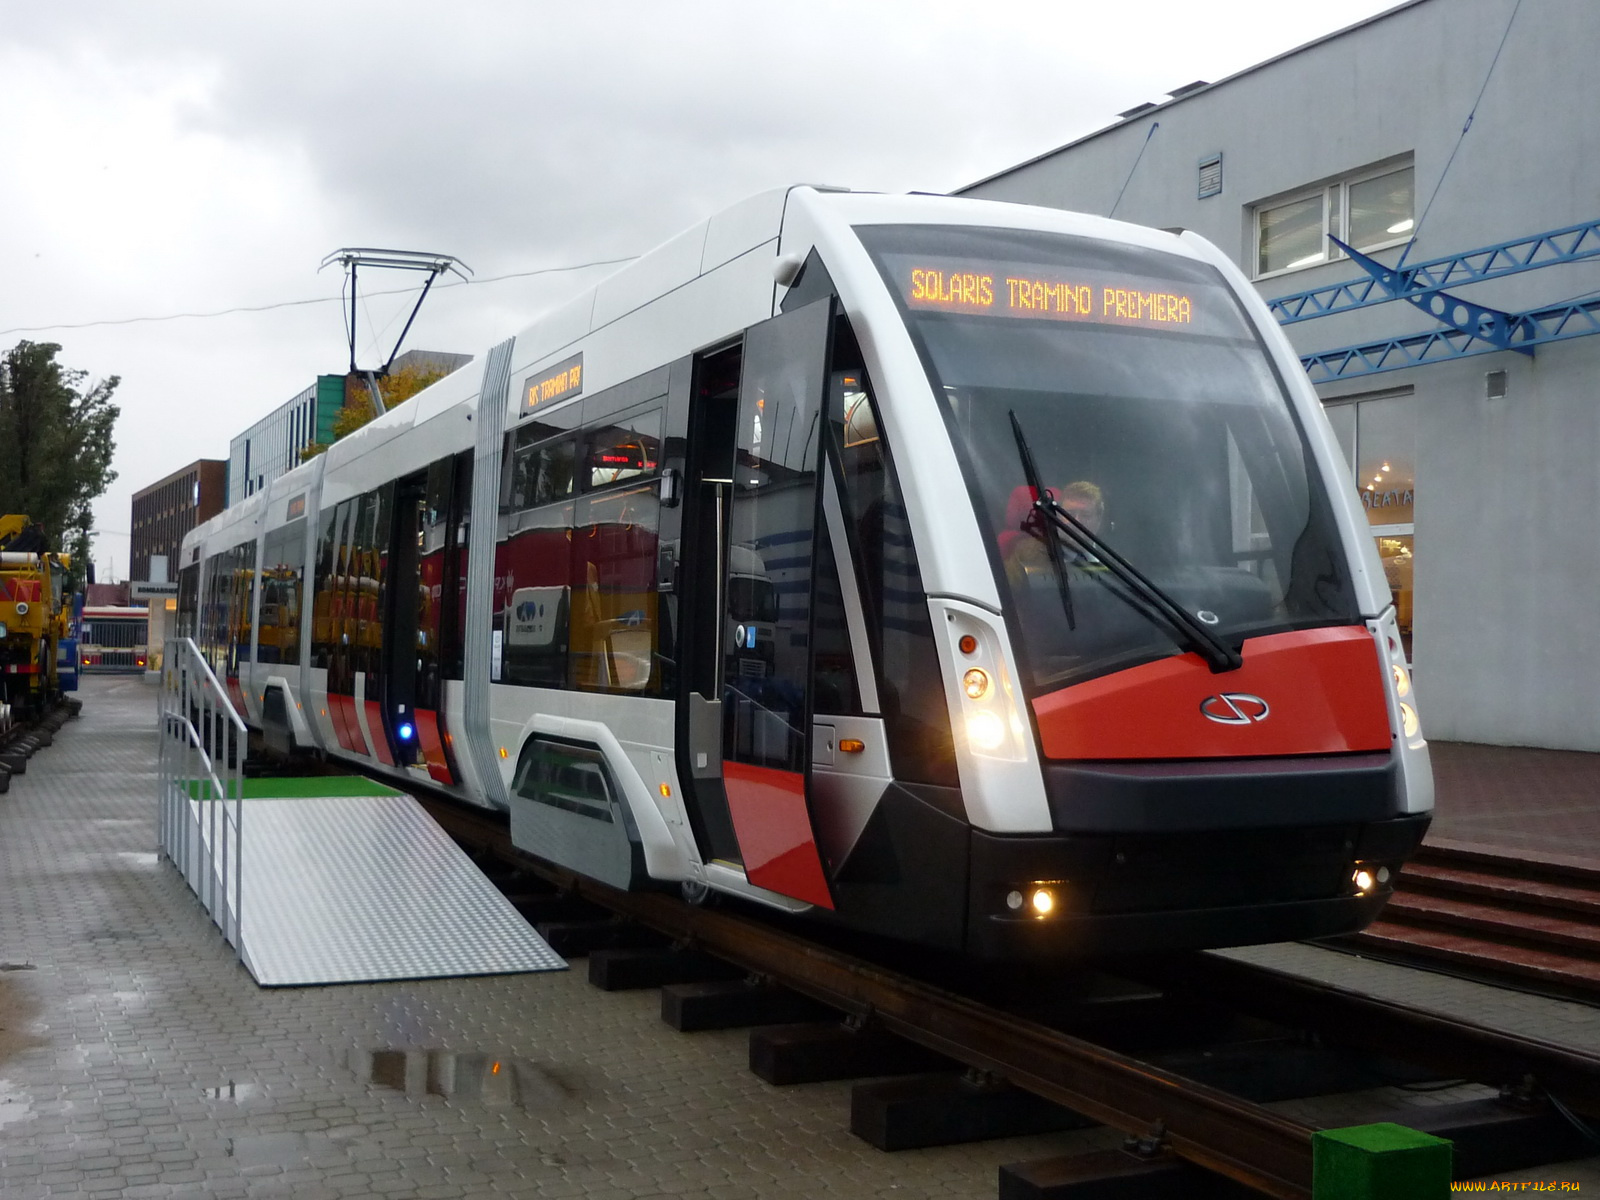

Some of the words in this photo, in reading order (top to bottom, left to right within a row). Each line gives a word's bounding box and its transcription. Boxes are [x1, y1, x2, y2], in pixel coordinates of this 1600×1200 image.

[911, 268, 993, 305] SOLARIS
[1006, 278, 1092, 315] TRAMINO
[1103, 288, 1191, 324] PREMIERA
